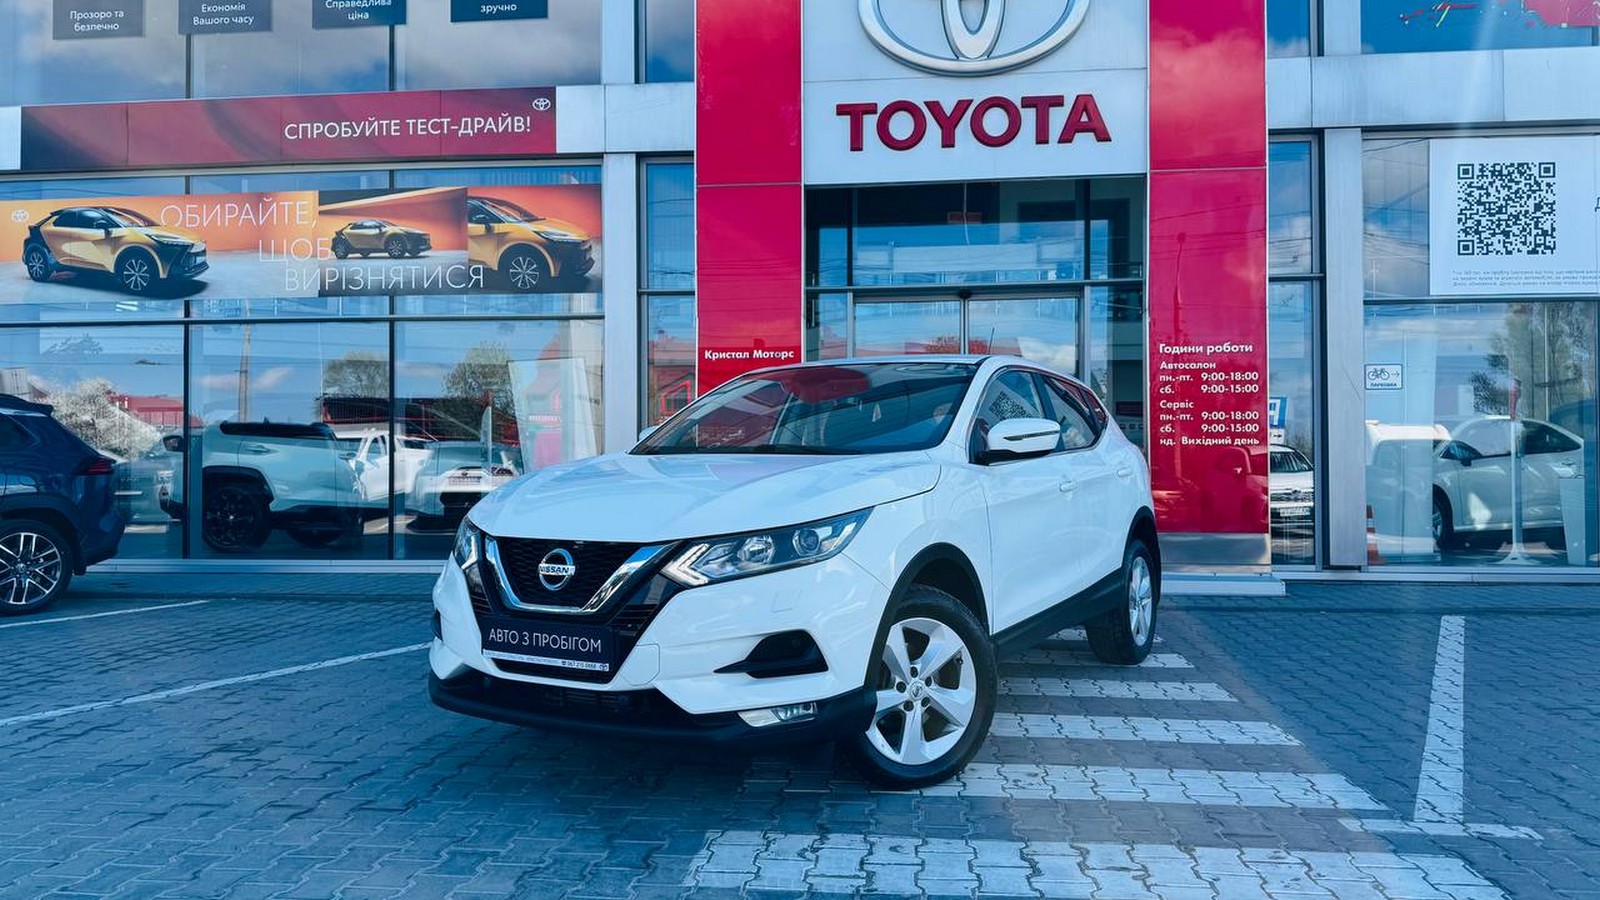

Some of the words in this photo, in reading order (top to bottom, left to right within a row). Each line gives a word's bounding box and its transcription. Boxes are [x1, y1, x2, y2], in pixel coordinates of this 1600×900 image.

[201, 3, 246, 13] Економія
[480, 4, 517, 14] зручно
[69, 10, 112, 21] Прозоро
[114, 11, 124, 19] та
[347, 11, 369, 21] ціна
[193, 16, 230, 26] Вашого
[232, 16, 255, 26] часу
[74, 22, 119, 31] безпечно
[284, 117, 400, 139] СПРОБУЙТЕ
[406, 113, 531, 137] ТЕСТ-ДРАЙВ!
[835, 94, 1112, 152] TOYOTA
[160, 197, 317, 228] ОБИРАЙТЕ,
[259, 237, 332, 262] ЩОБ
[284, 265, 485, 291] ВИРІЗНЯТИСЯ
[1159, 344, 1203, 354] Години
[1207, 342, 1253, 355] роботи
[704, 349, 750, 361] Кристал
[753, 348, 795, 360] Моторс
[1160, 361, 1216, 370] Автосалон
[1201, 372, 1259, 381] 9:00-18:00
[1160, 385, 1175, 393] сб.
[1201, 384, 1259, 393] 9:00-15:00
[1160, 400, 1194, 410] Сервіс
[1160, 413, 1194, 421] пн.-пт.
[1201, 411, 1259, 420] 9:00-18:00
[1160, 424, 1175, 433] сб.
[1201, 424, 1259, 433] 9:00-15:00
[1181, 436, 1231, 446] Вихідний
[1233, 438, 1260, 446] день
[539, 565, 570, 574] NISSAN
[488, 628, 519, 645] АВТО
[522, 633, 530, 645] З
[532, 633, 602, 653] ПРОБІГОМ
